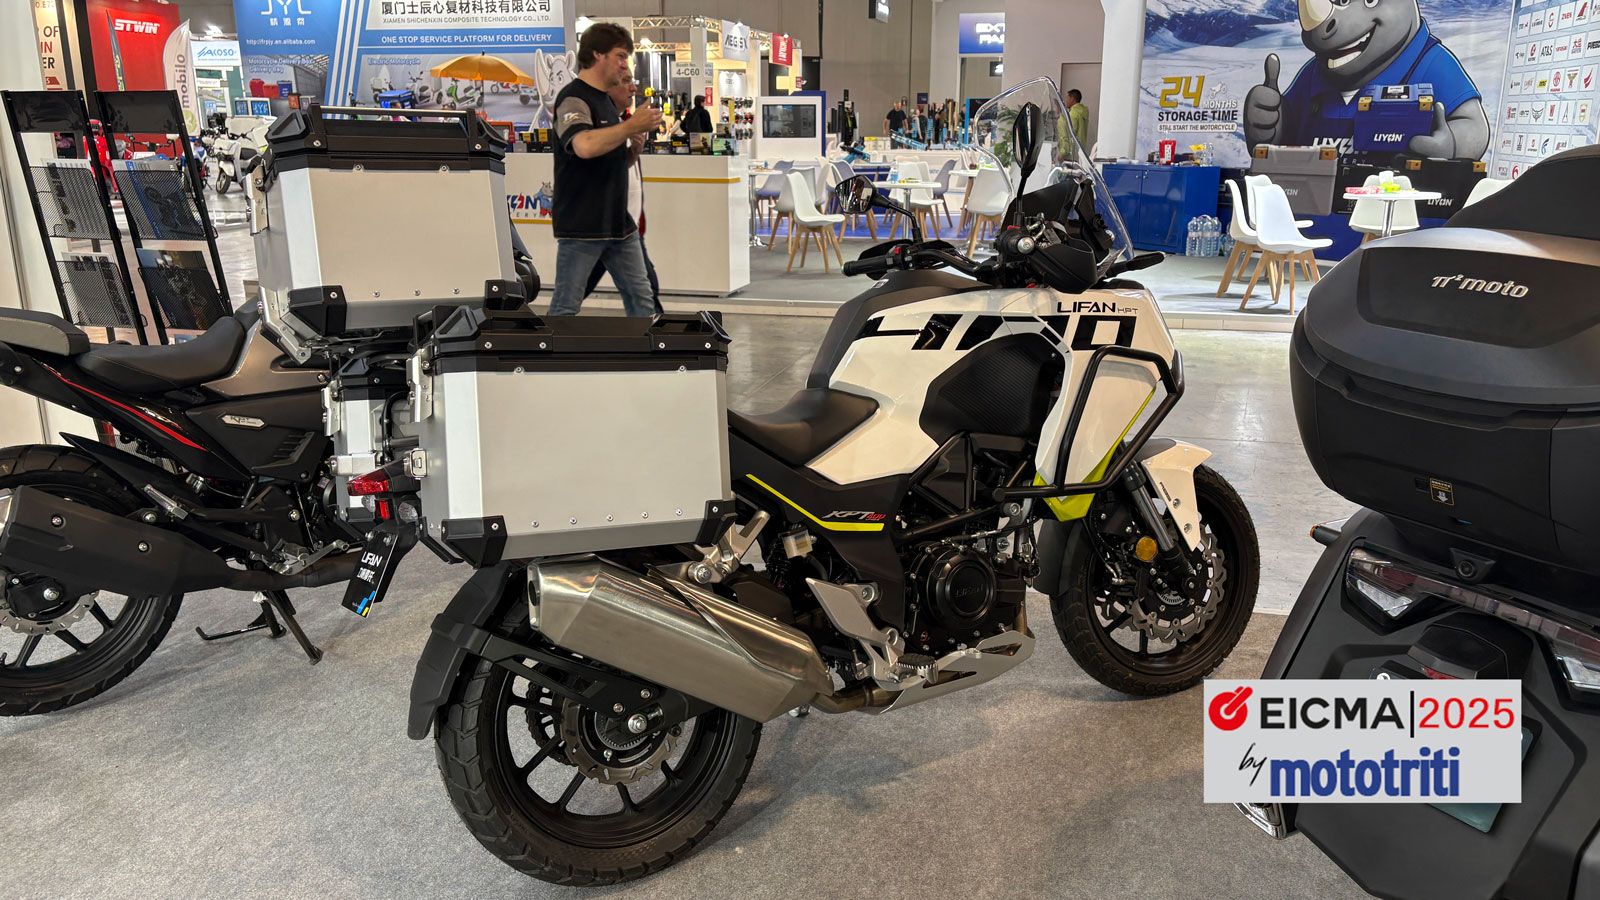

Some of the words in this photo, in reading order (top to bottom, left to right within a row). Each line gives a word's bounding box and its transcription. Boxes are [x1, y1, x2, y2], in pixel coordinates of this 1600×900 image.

[480, 15, 522, 23] TECHNOLOGY
[381, 36, 397, 44] ONE
[420, 35, 452, 43] SERVICE
[454, 34, 495, 43] PLATFORM
[496, 34, 513, 42] FOR
[513, 33, 552, 42] DELIVERY
[676, 67, 700, 77] 4-C60
[1159, 75, 1205, 109] 24
[1202, 99, 1238, 110] MONTHS
[1158, 111, 1208, 122] STORAGE
[1211, 110, 1238, 121] TIME
[1199, 123, 1235, 131] MOTORCYCLE
[1057, 301, 1116, 313] LIFAN
